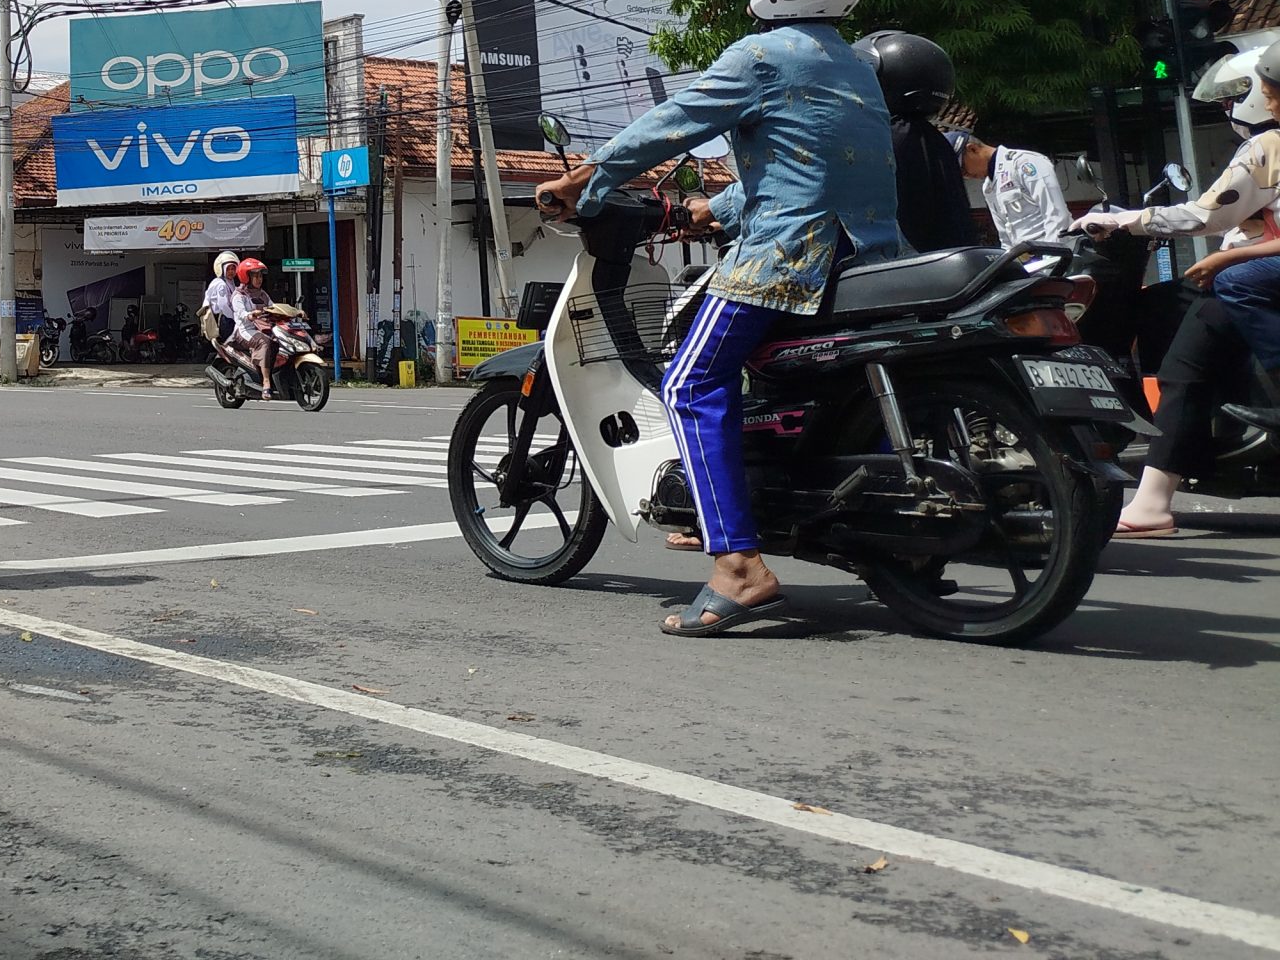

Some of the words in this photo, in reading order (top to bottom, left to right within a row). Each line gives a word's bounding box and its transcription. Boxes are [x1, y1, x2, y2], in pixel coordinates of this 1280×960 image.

[626, 4, 650, 15] Galaxy
[480, 51, 531, 67] AMSUNG
[101, 47, 289, 99] oppo
[86, 121, 251, 171] vivo
[339, 155, 352, 177] hp
[142, 183, 198, 197] IMAGO
[468, 331, 527, 340] PEMBERITAHUAN
[775, 341, 835, 360] Astrea
[1029, 366, 1045, 386] B
